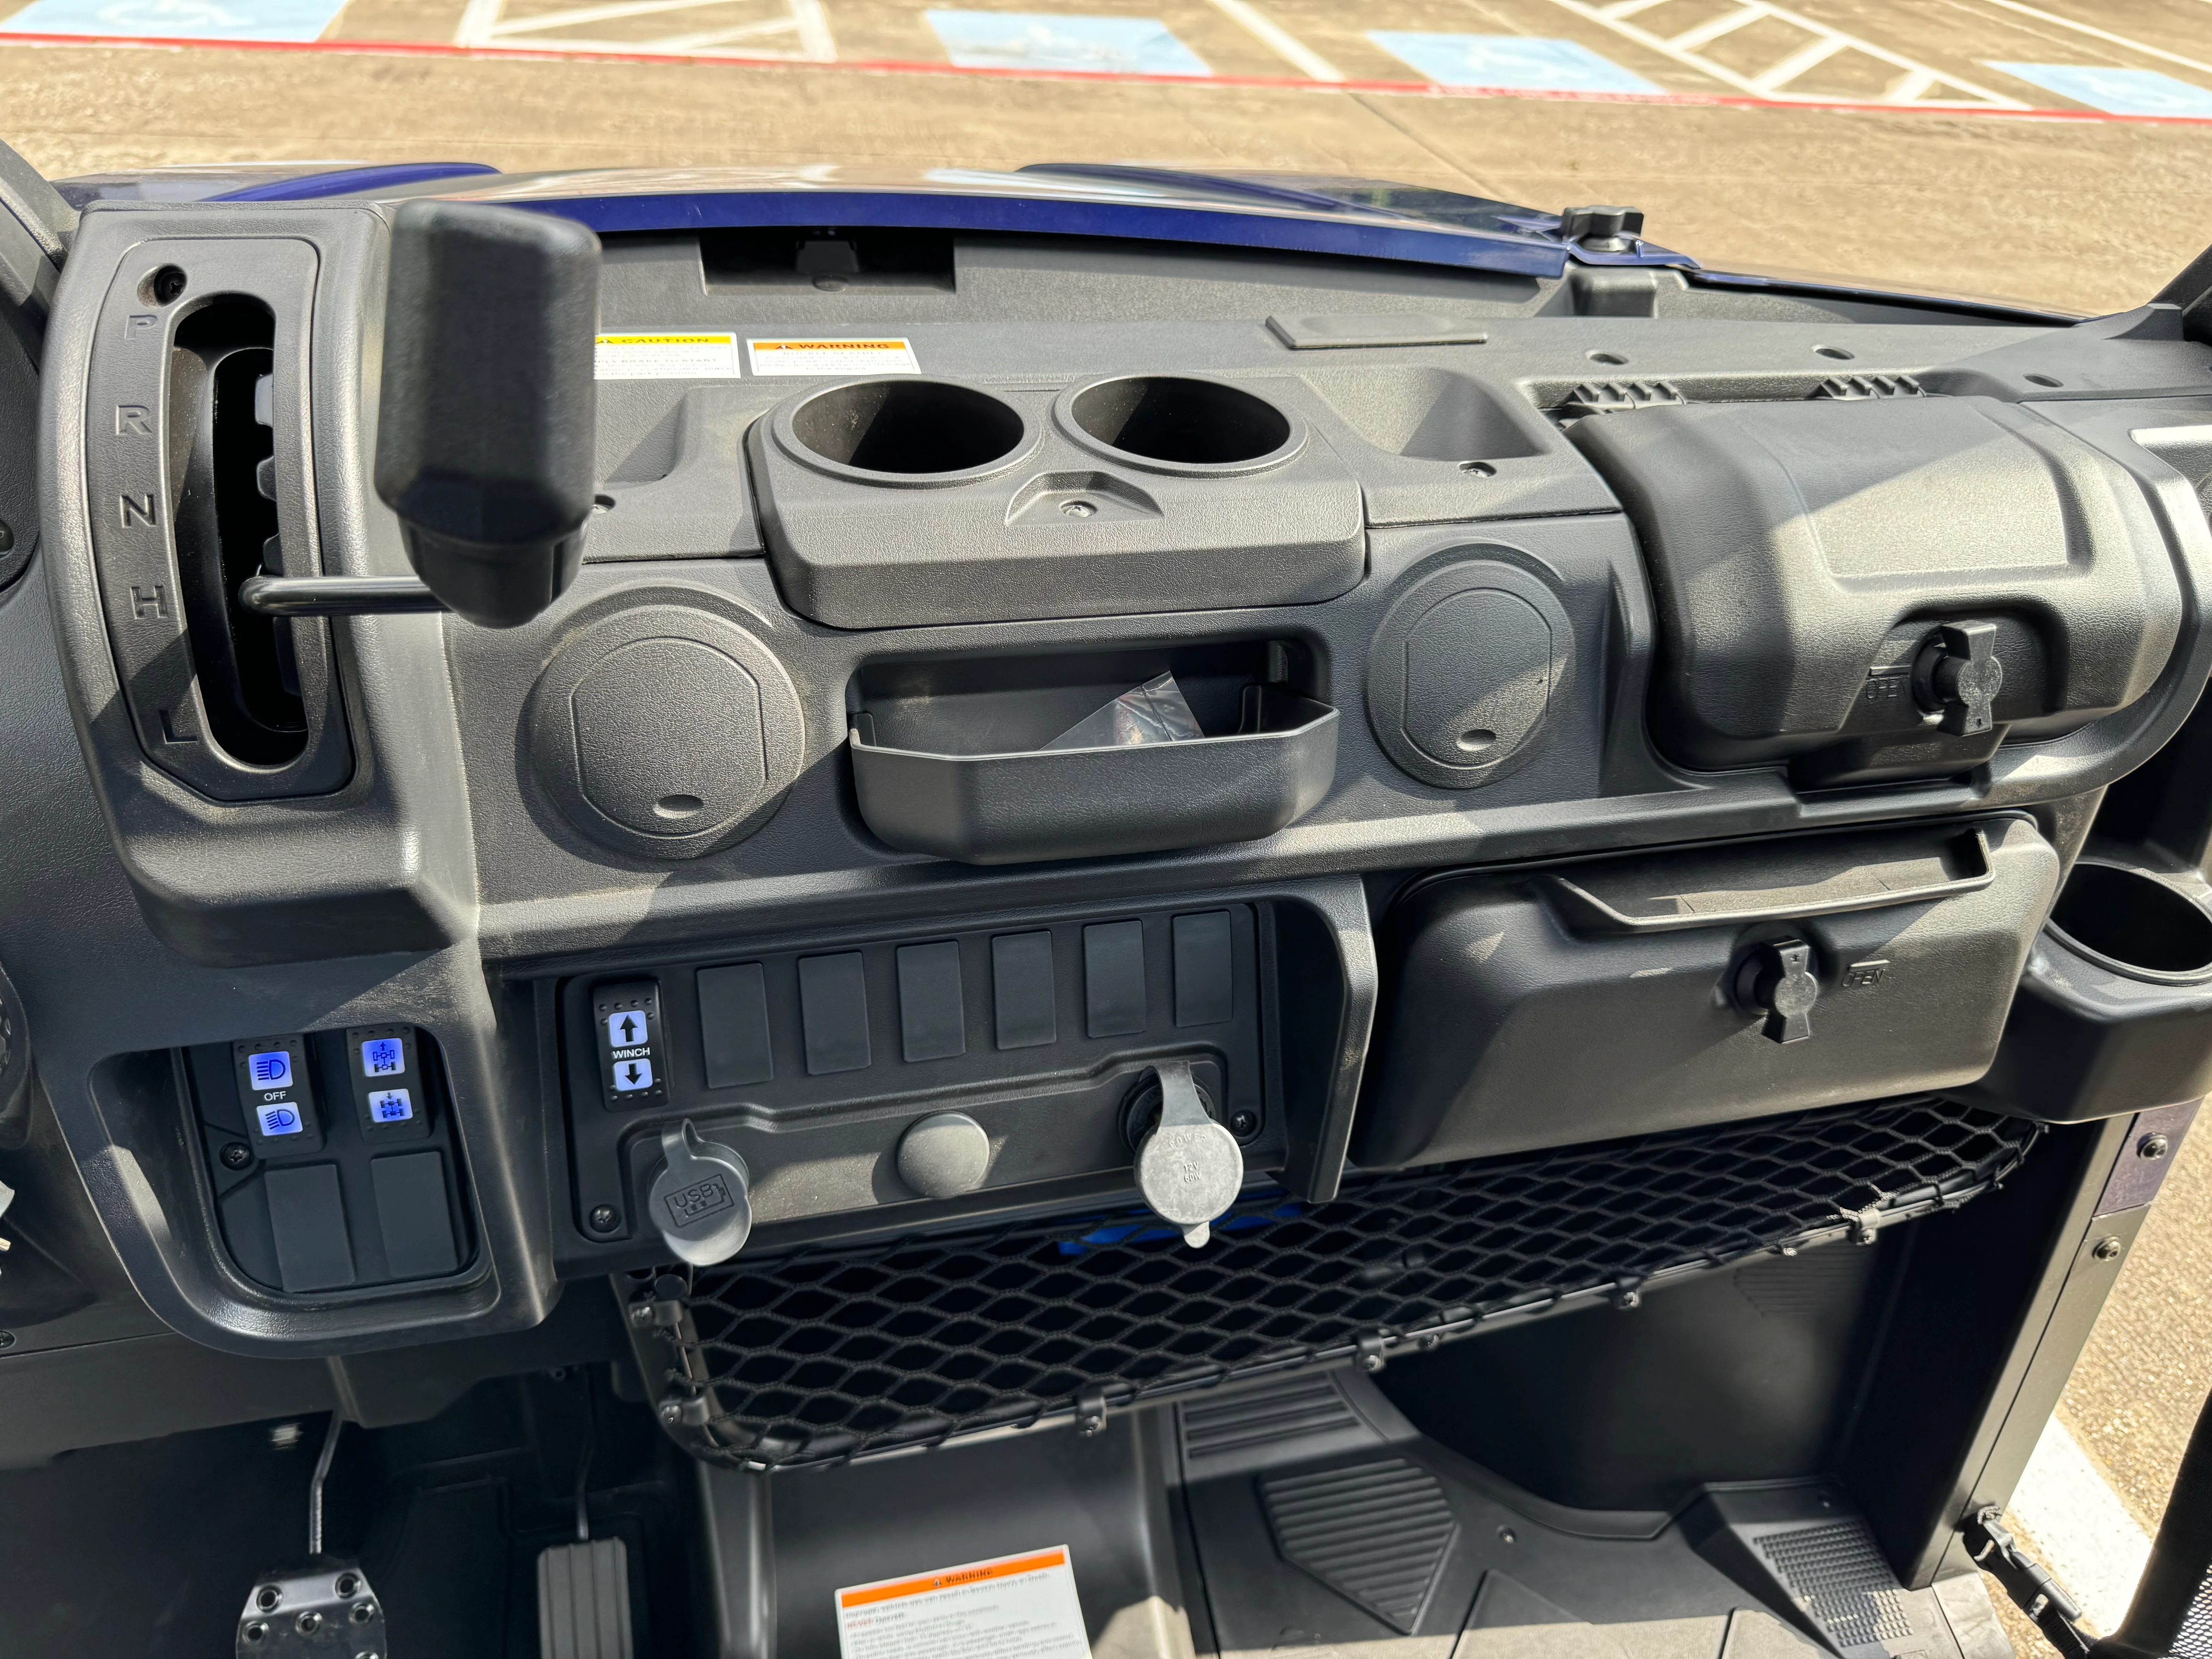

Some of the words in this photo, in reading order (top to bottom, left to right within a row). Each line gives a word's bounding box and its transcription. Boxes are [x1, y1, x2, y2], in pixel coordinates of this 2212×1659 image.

[125, 315, 156, 340] P
[115, 405, 153, 438] R
[119, 494, 156, 528] N
[130, 586, 169, 619] H
[160, 709, 198, 744] L
[1841, 969, 1885, 987] OPEN
[611, 1047, 651, 1059] WINCH
[264, 1091, 286, 1101] OFF
[1168, 1132, 1207, 1149] POWER
[1183, 1160, 1199, 1172] 12V
[1183, 1171, 1202, 1183] 60W
[674, 1183, 713, 1208] USB
